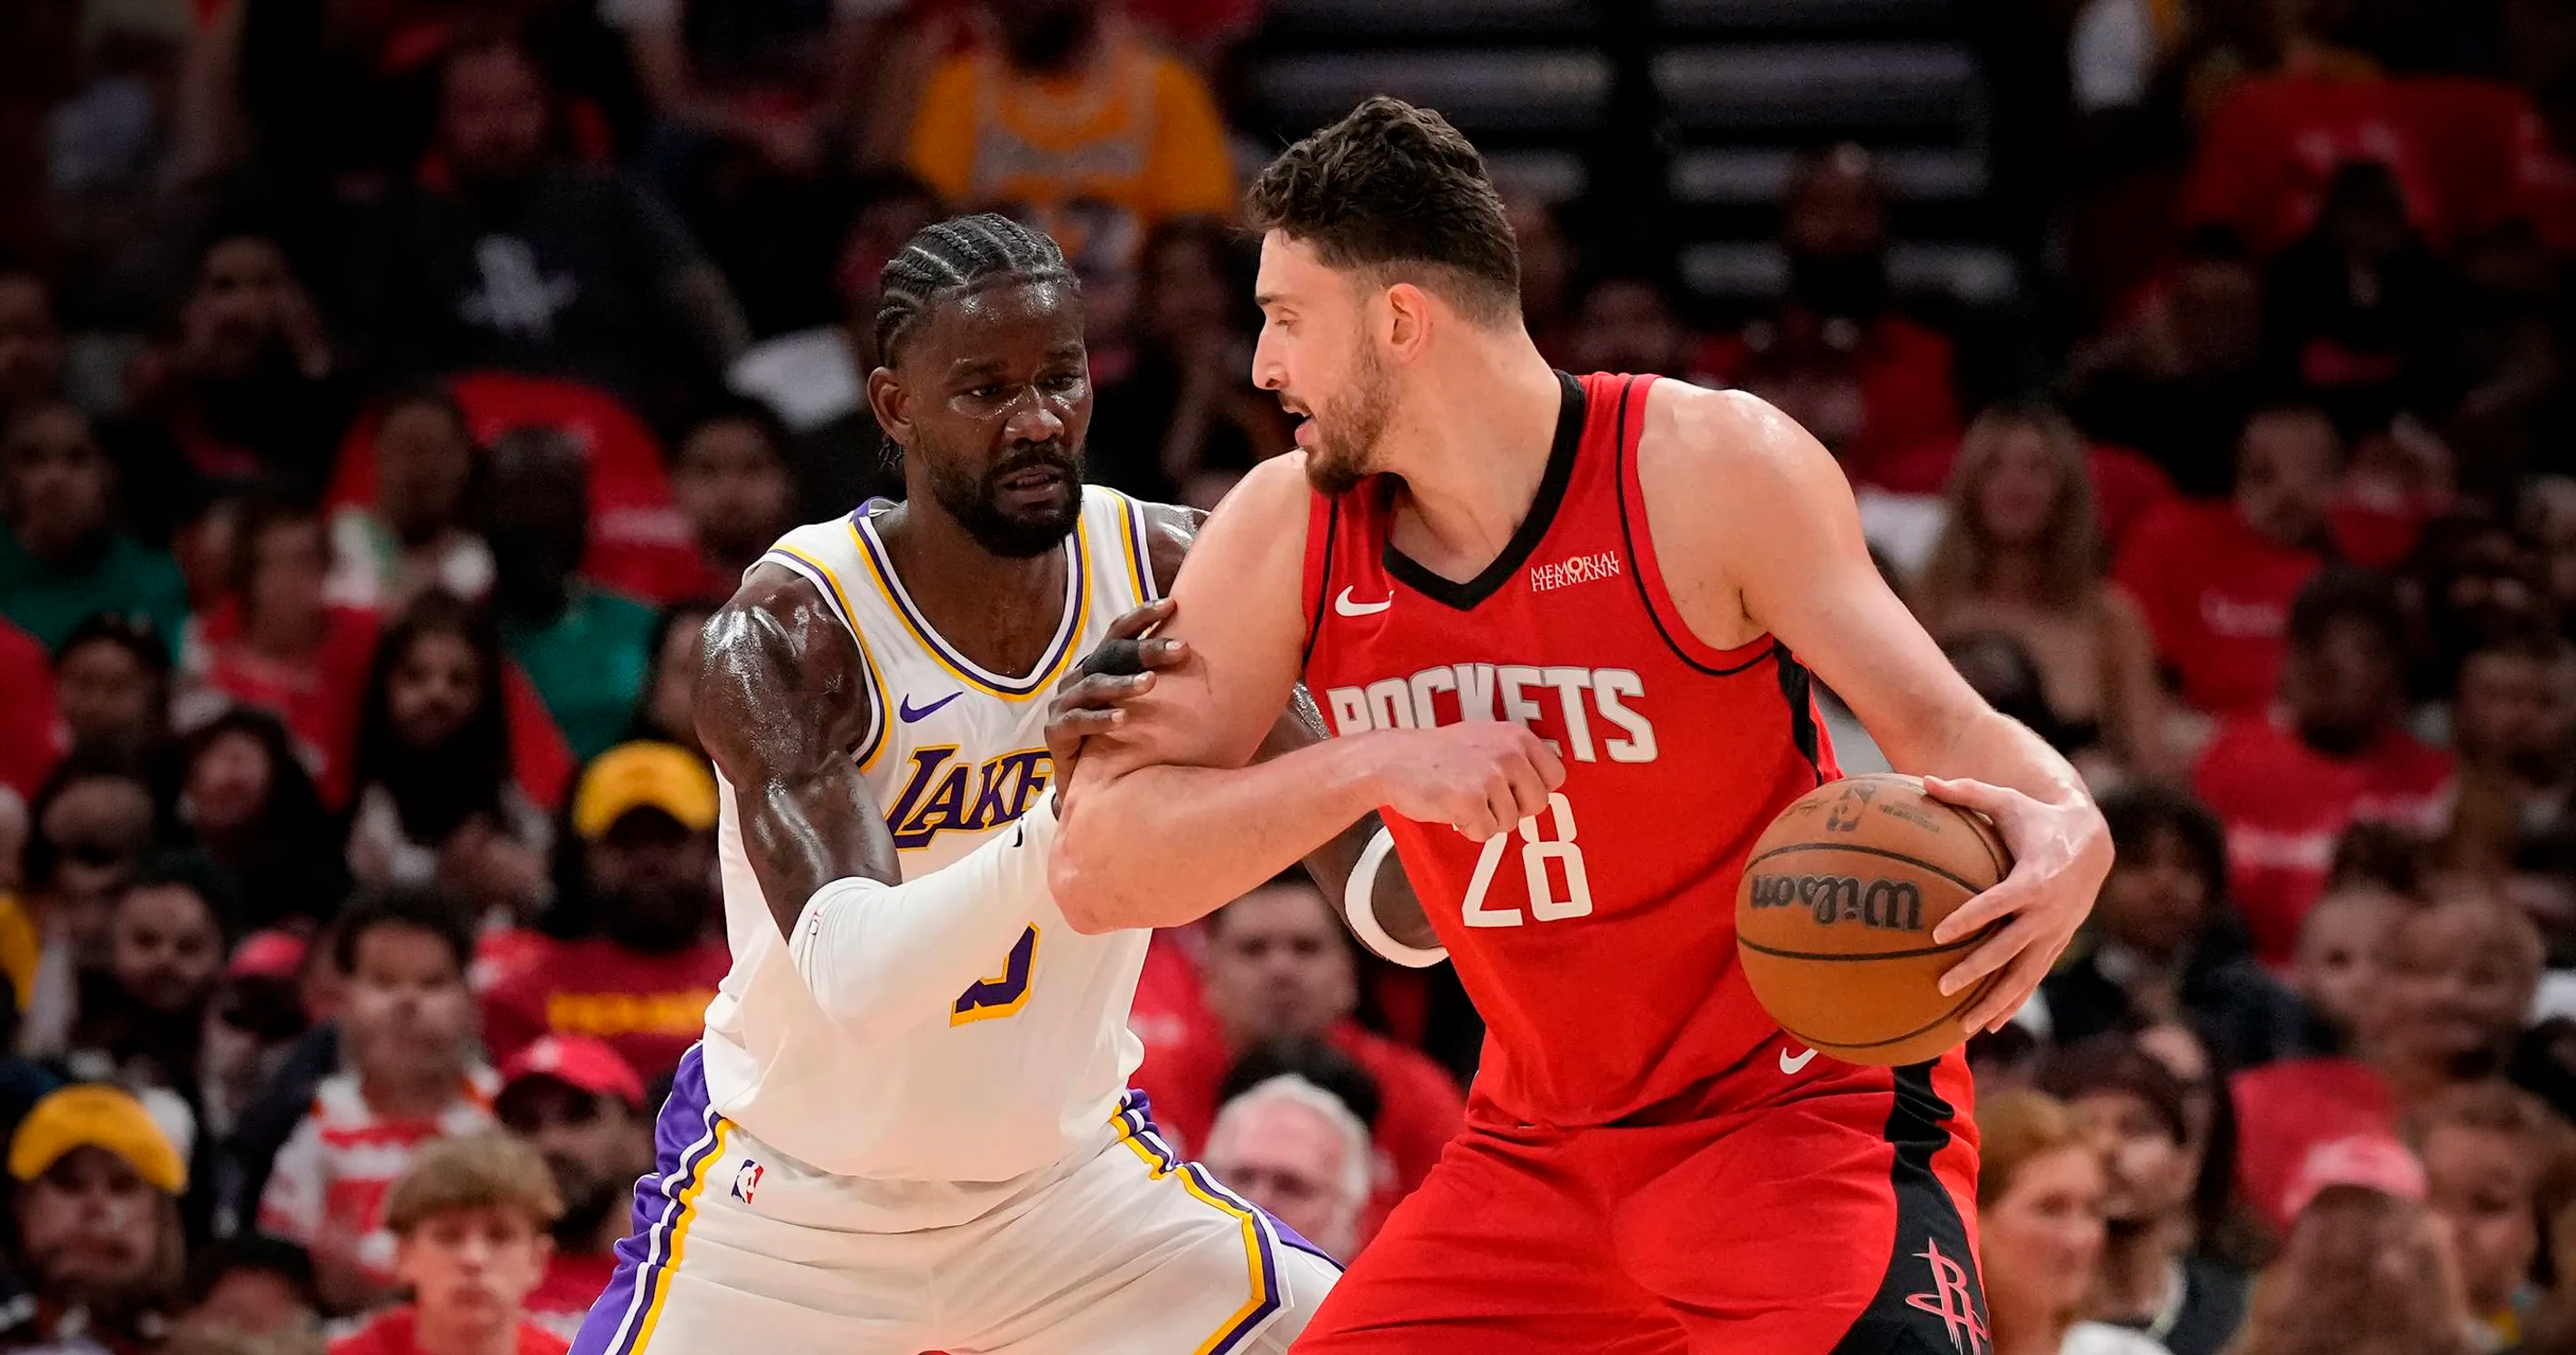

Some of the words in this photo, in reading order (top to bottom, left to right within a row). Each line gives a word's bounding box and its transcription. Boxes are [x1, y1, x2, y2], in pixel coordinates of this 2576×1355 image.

[1530, 550, 1616, 581] MEMORIAL
[1531, 559, 1620, 593] HERMANN
[885, 743, 1057, 852] LAKE
[1451, 791, 1593, 928] 28
[1750, 874, 1925, 931] Wilson
